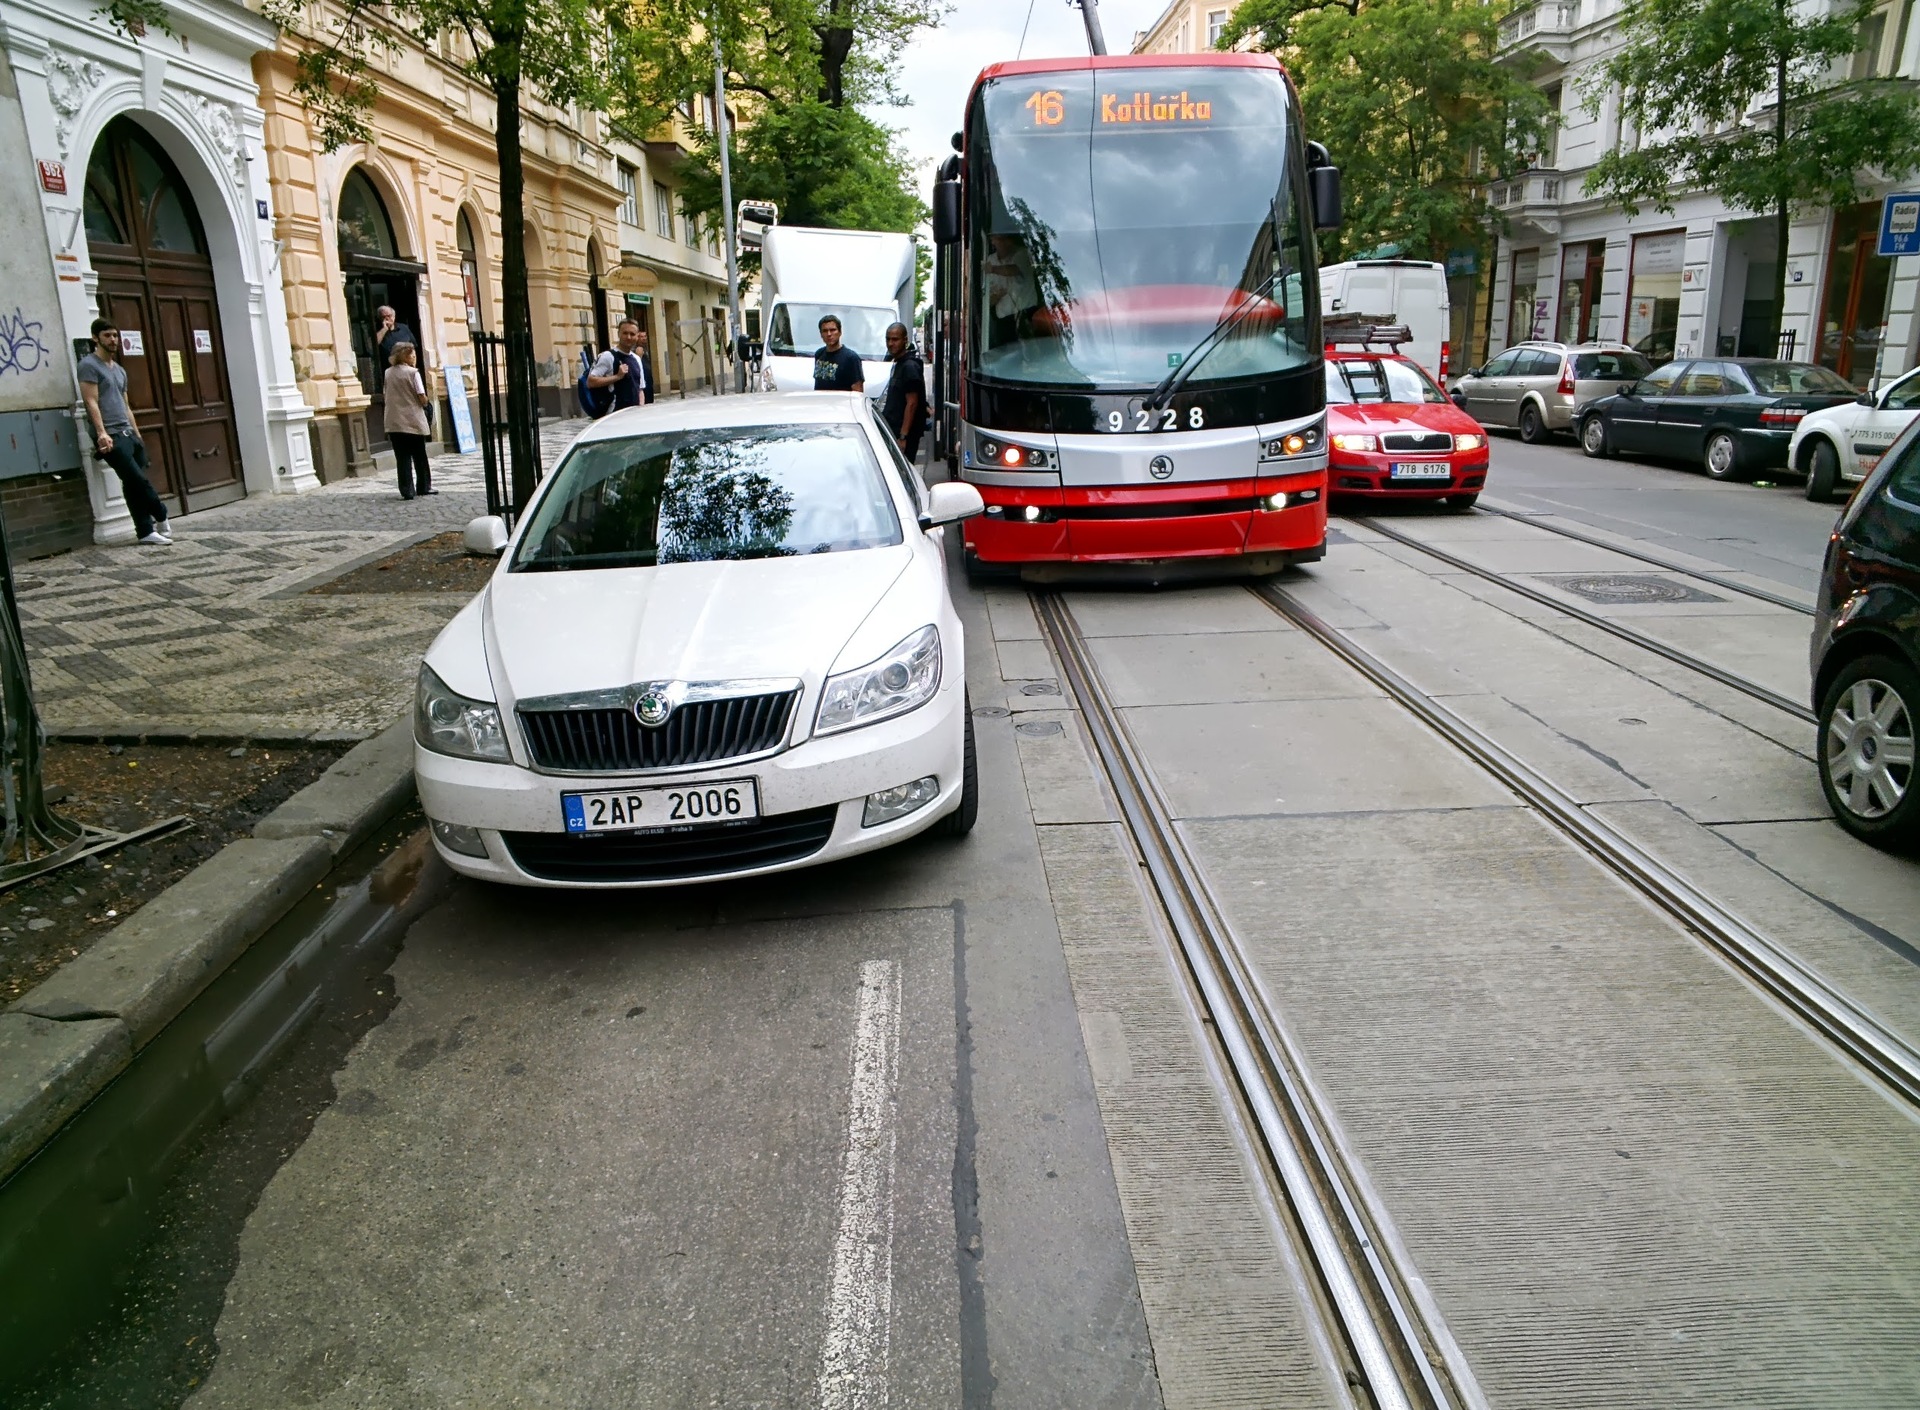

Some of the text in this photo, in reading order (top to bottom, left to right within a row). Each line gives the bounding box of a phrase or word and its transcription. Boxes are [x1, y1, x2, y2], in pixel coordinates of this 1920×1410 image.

[1025, 90, 1064, 125] 16
[43, 161, 62, 177] 962
[1893, 242, 1906, 251] FM
[1108, 406, 1204, 432] 9228
[1858, 430, 1869, 438] 775
[1399, 464, 1417, 474] 7T8
[1423, 464, 1446, 474] 6176
[589, 787, 741, 826] 2AP 2006
[569, 817, 584, 827] CZ
